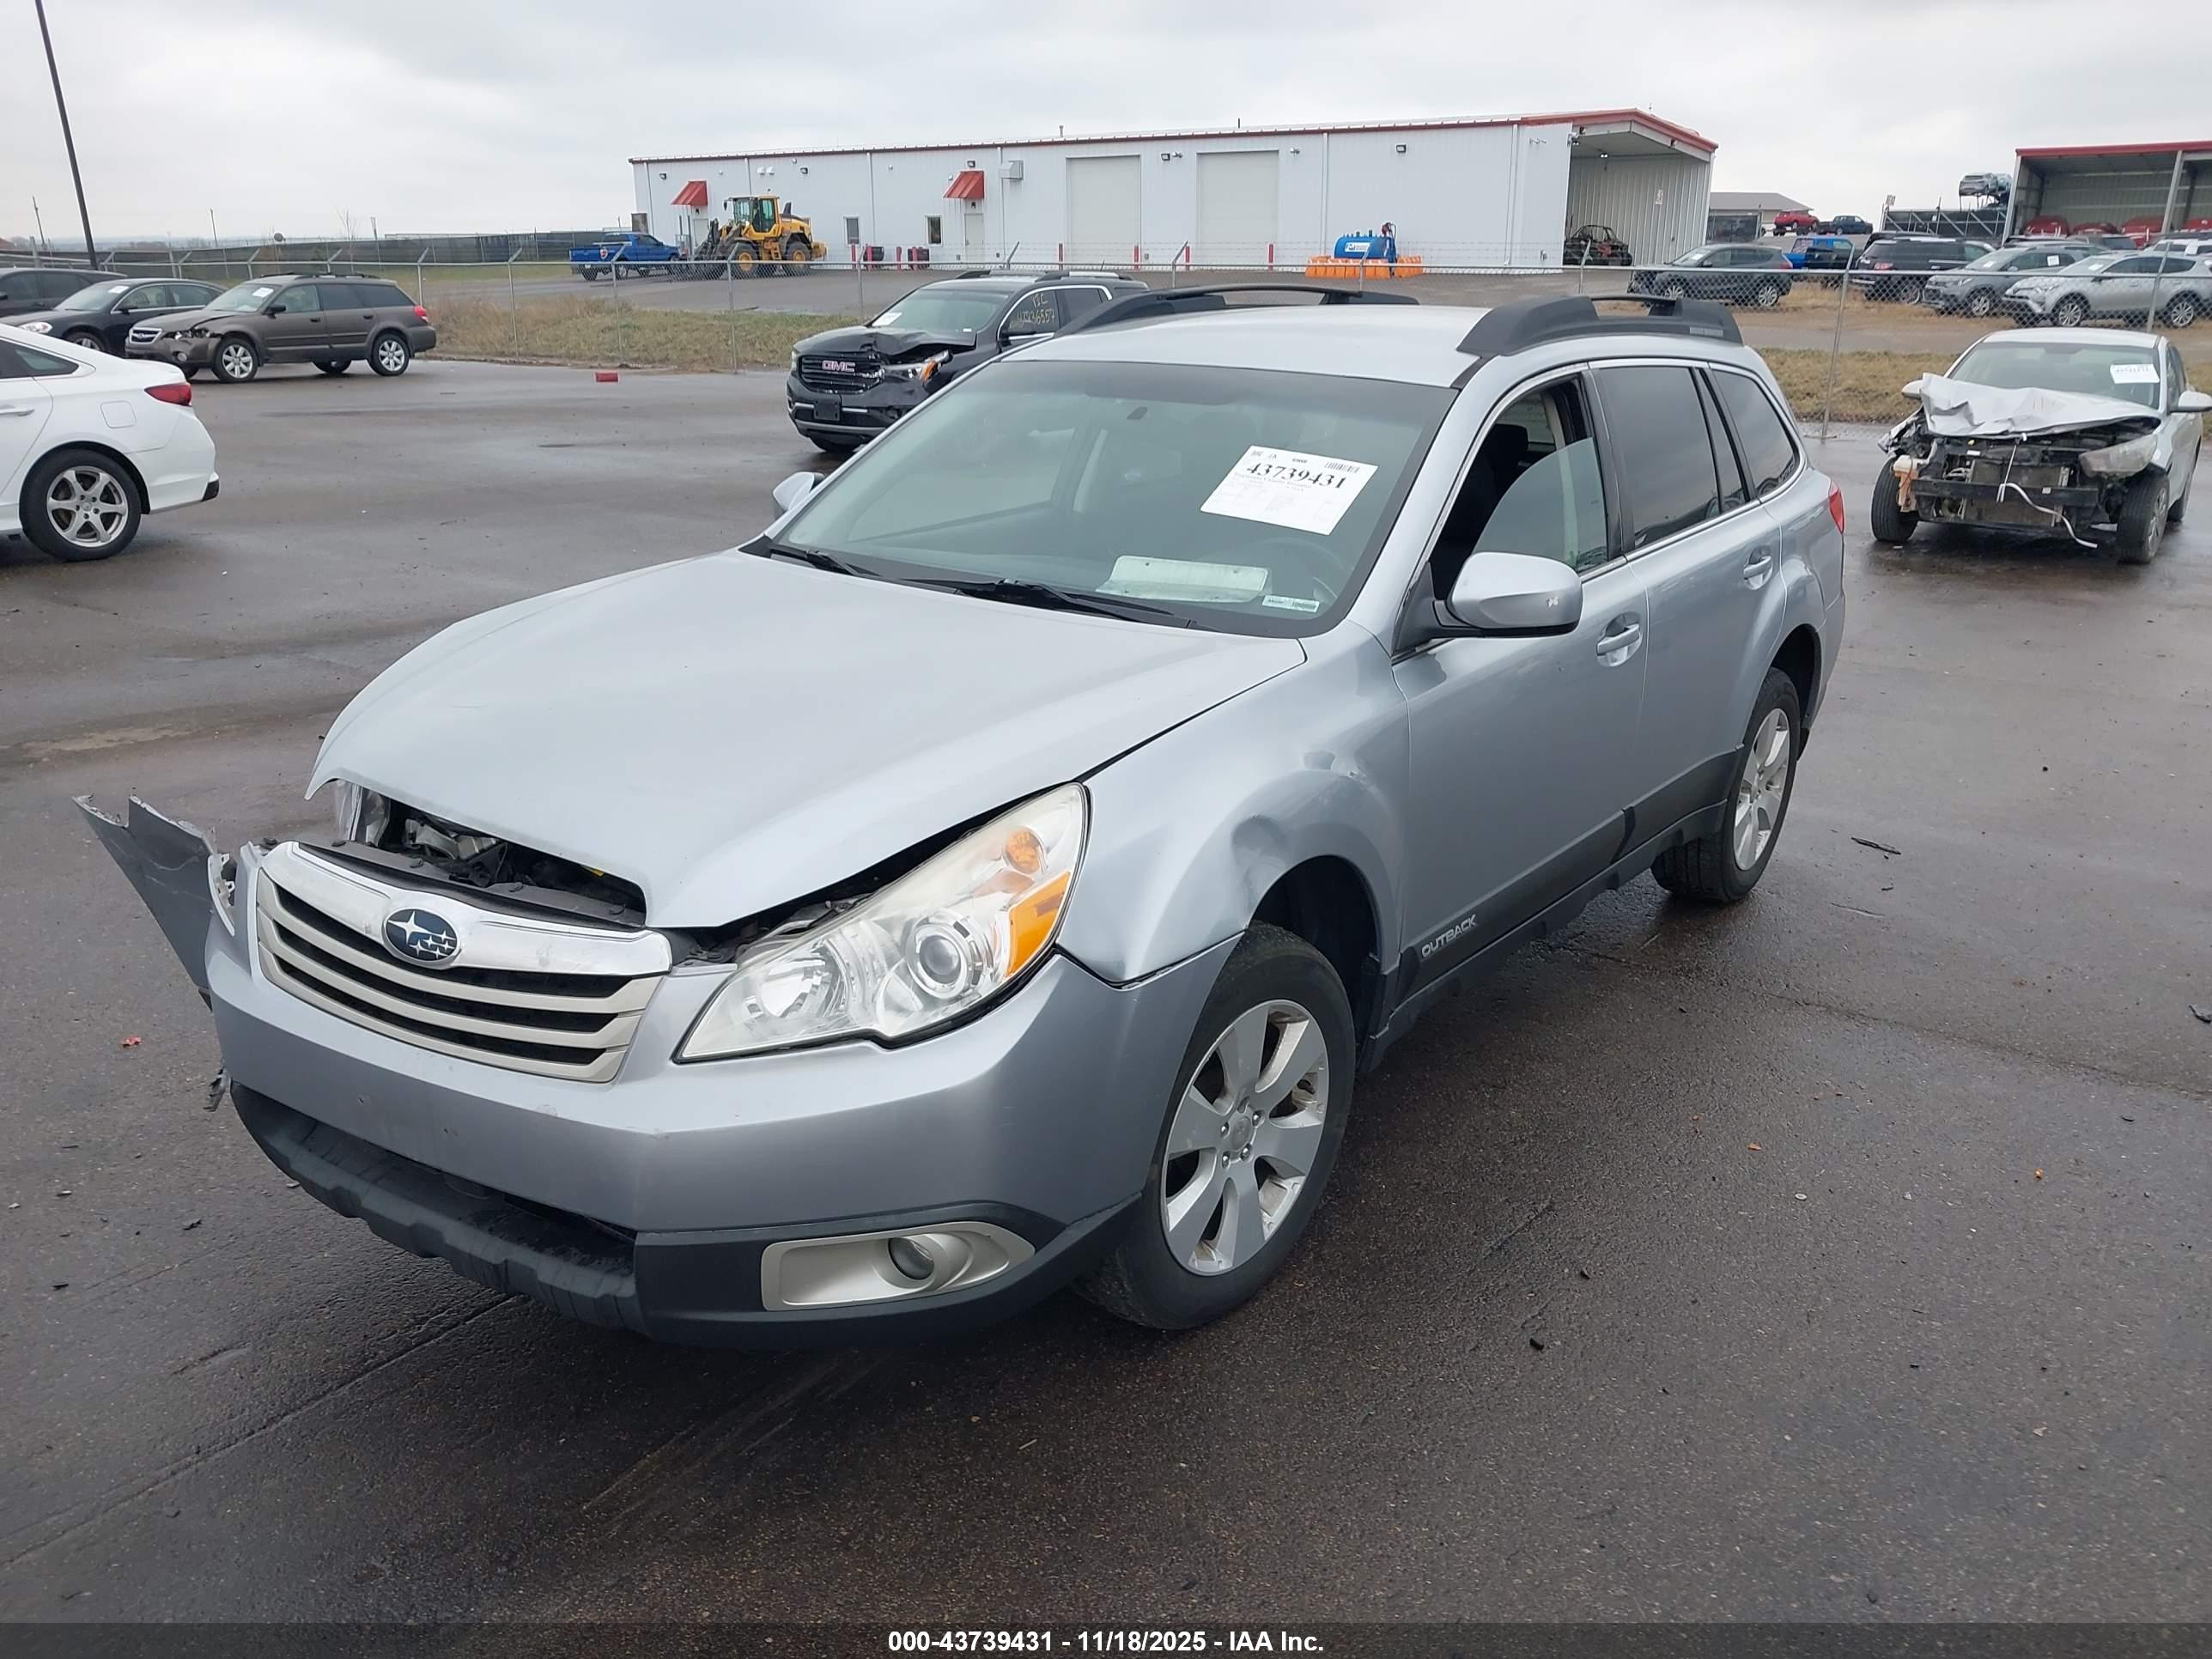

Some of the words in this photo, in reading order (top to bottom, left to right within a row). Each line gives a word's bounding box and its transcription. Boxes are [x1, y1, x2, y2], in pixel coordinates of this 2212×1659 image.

[823, 360, 856, 372] GMC
[1247, 463, 1346, 489] 43739431
[1421, 914, 1477, 957] OUTBACK
